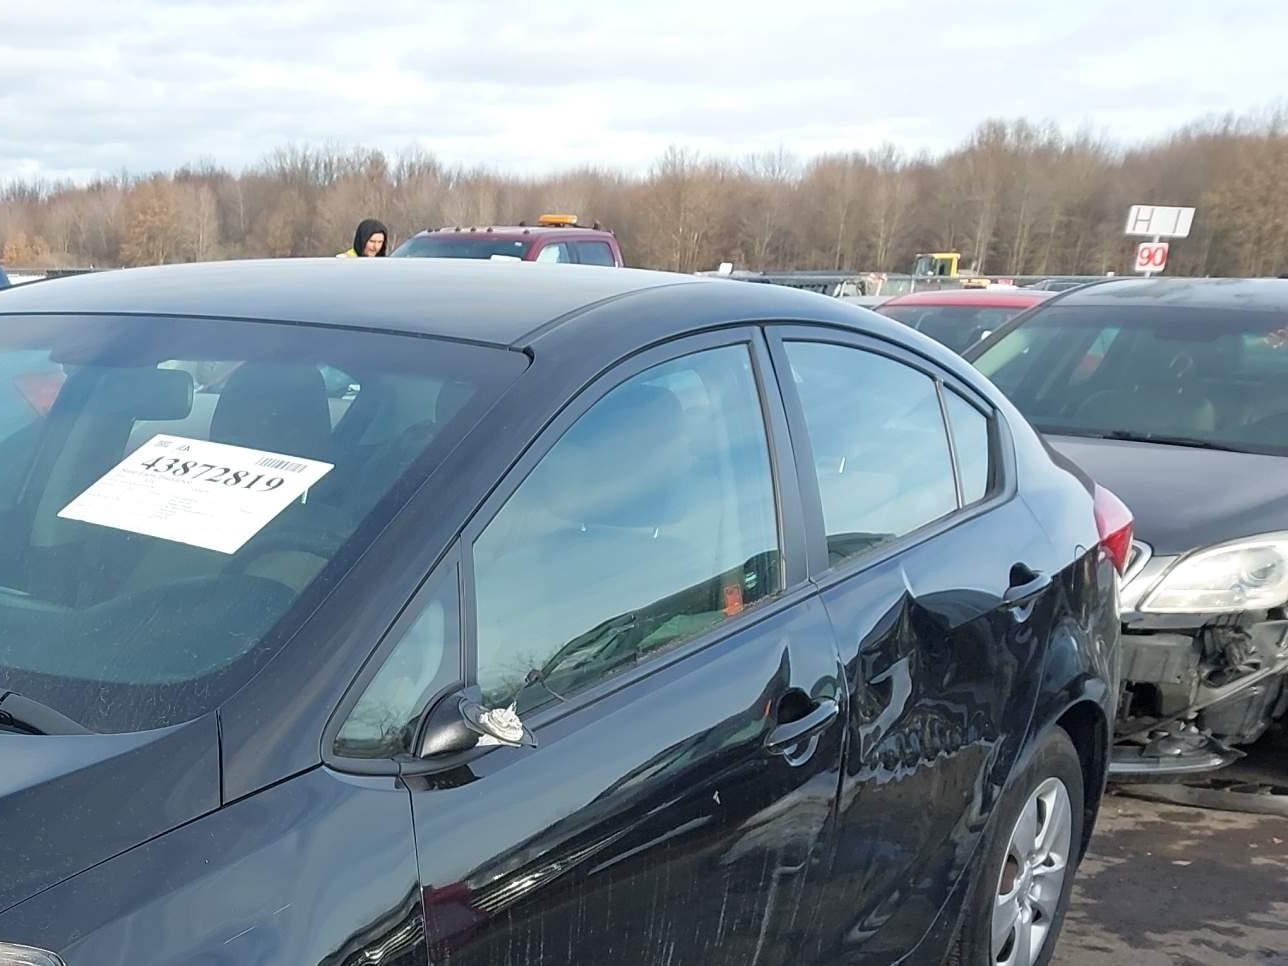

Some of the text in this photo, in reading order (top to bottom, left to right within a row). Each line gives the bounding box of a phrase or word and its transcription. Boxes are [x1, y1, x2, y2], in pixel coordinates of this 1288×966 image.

[1133, 207, 1155, 232] H
[1138, 246, 1166, 267] 90
[140, 455, 286, 492] 43872819
